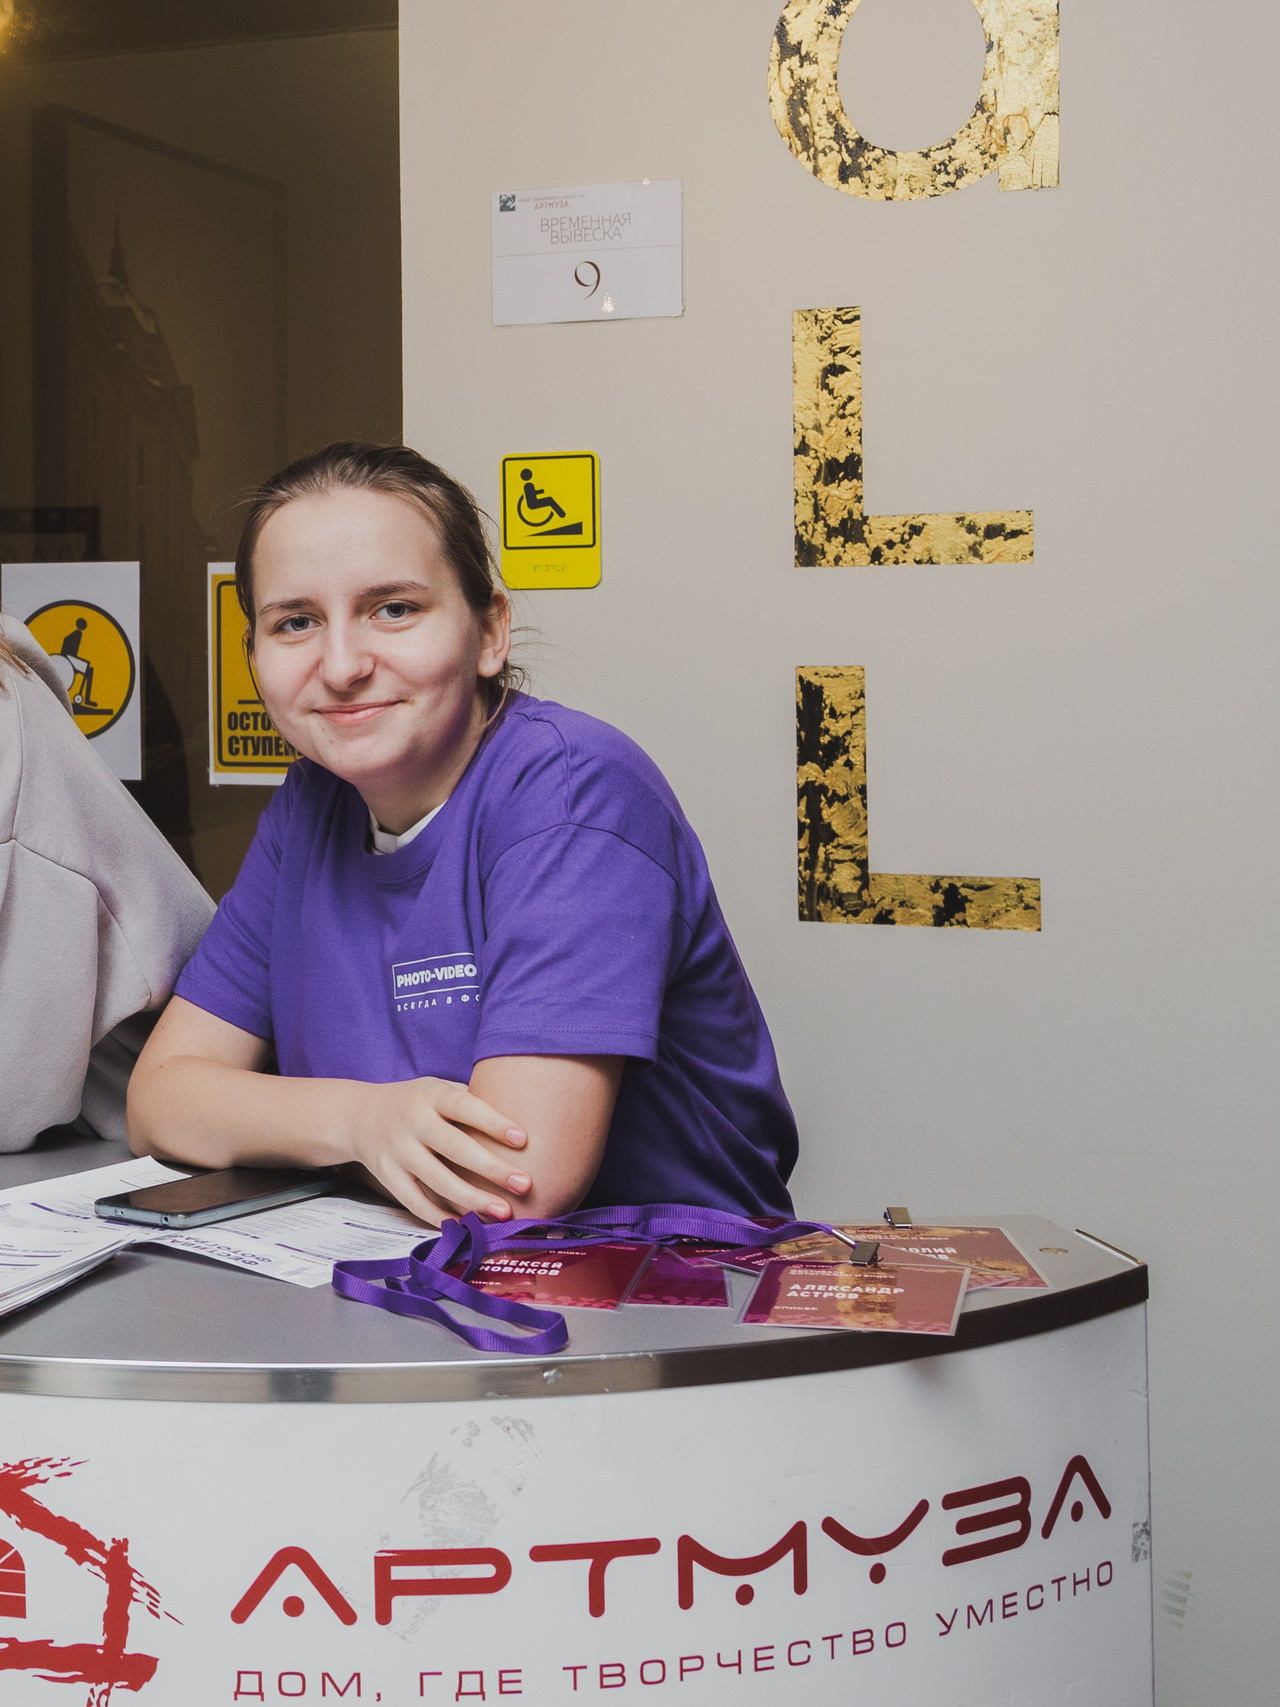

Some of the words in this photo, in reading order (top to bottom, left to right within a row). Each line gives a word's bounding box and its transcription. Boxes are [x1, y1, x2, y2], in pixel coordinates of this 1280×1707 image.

[533, 200, 570, 211] АРТМУЗА
[540, 212, 632, 233] ВРЕМЕННАЯ
[550, 226, 623, 245] ВЫВЕСКА
[574, 260, 601, 301] 9
[227, 711, 276, 731] ОСТО
[228, 735, 304, 757] СТУПЕН
[396, 963, 478, 988] PHOTO-VIDEO
[396, 998, 437, 1012] ВСЕГДА
[446, 996, 453, 1005] В
[479, 1265, 560, 1276] НОВИКОВ
[483, 1258, 563, 1269] АЛЕКСЕЙ
[786, 1291, 860, 1300] АСТРОВ
[789, 1284, 905, 1294] АЛЕКСАНДР
[230, 1454, 1112, 1626] АРТМУЗА
[234, 1670, 381, 1702] ДОМ,
[419, 1669, 523, 1702] ГДЕ
[562, 1621, 907, 1693] ТВОРЧЕСТВО
[935, 1560, 1114, 1636] УМЕСТНО
